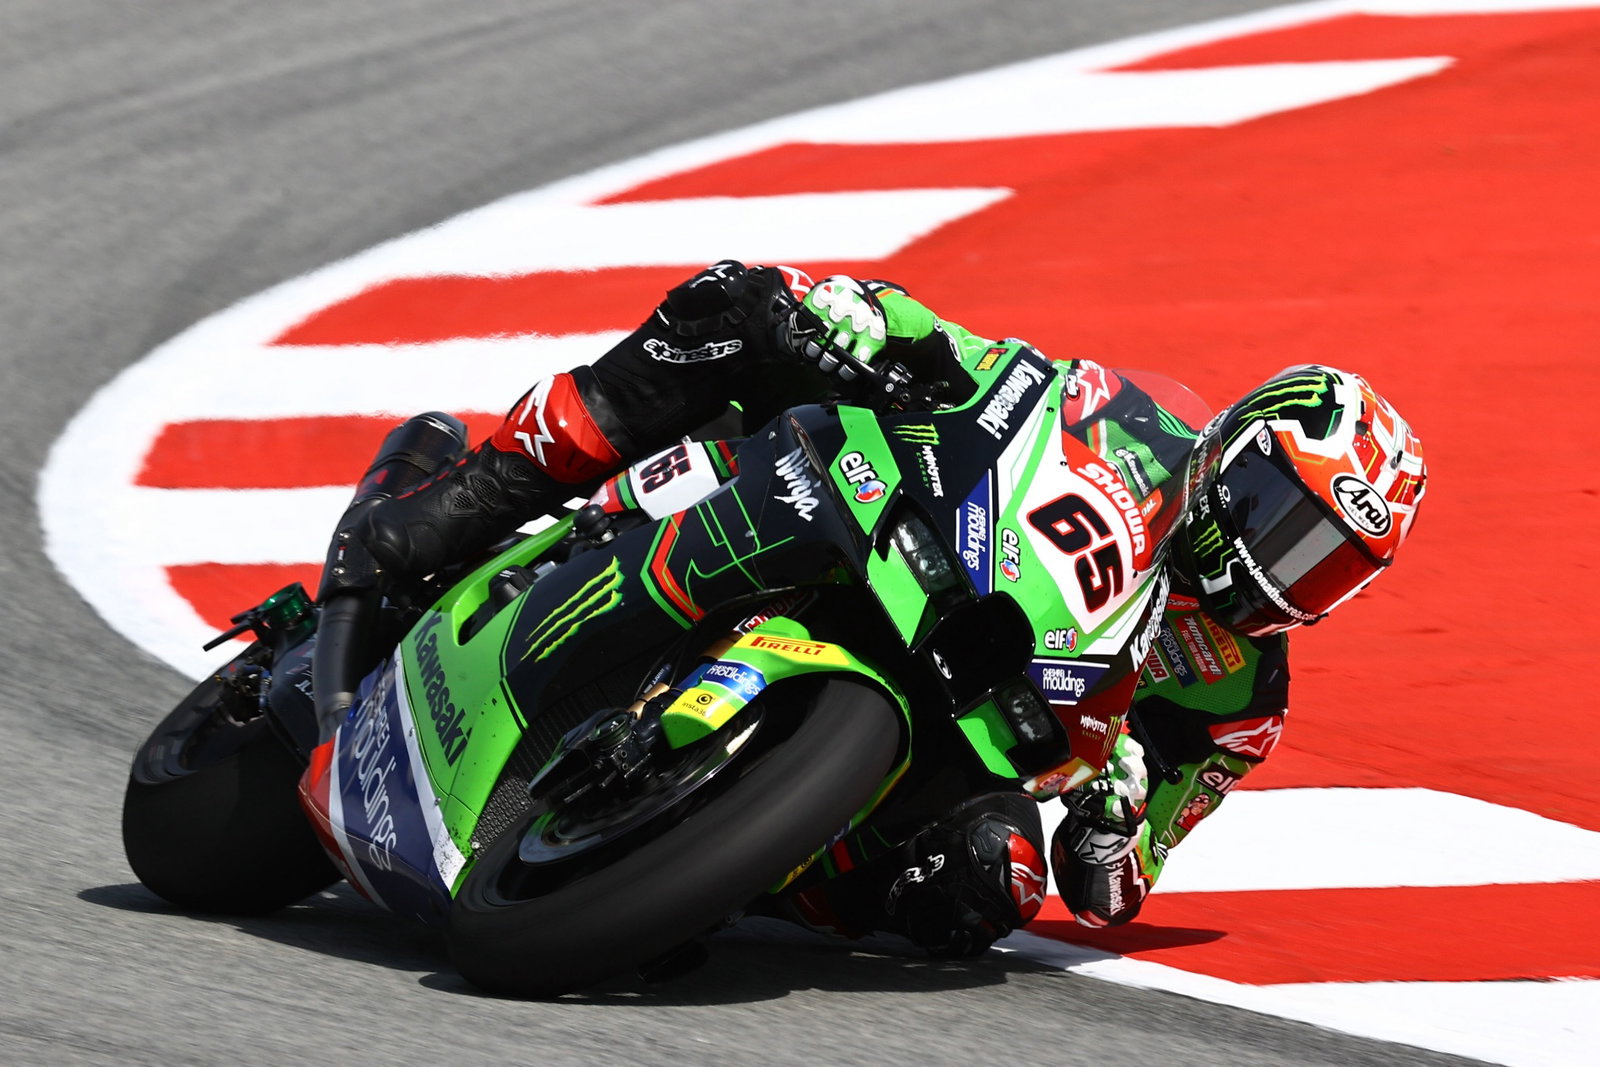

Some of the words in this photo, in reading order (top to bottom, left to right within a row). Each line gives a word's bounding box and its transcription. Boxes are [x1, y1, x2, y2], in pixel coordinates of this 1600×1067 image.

[643, 338, 742, 363] alpinestars
[976, 359, 1046, 440] Kawasaki
[774, 446, 820, 521] Ninja
[840, 452, 876, 484] elf
[922, 445, 944, 498] MONSTER
[1077, 463, 1146, 556] SHOWA
[1334, 486, 1389, 529] Arai
[963, 502, 986, 571] mouldings
[1002, 528, 1020, 563] elf
[1026, 492, 1124, 613] 65
[750, 636, 826, 656] PIRELLI
[1044, 628, 1066, 649] elf
[414, 606, 473, 768] Kawasaki
[1042, 669, 1085, 698] mouldings
